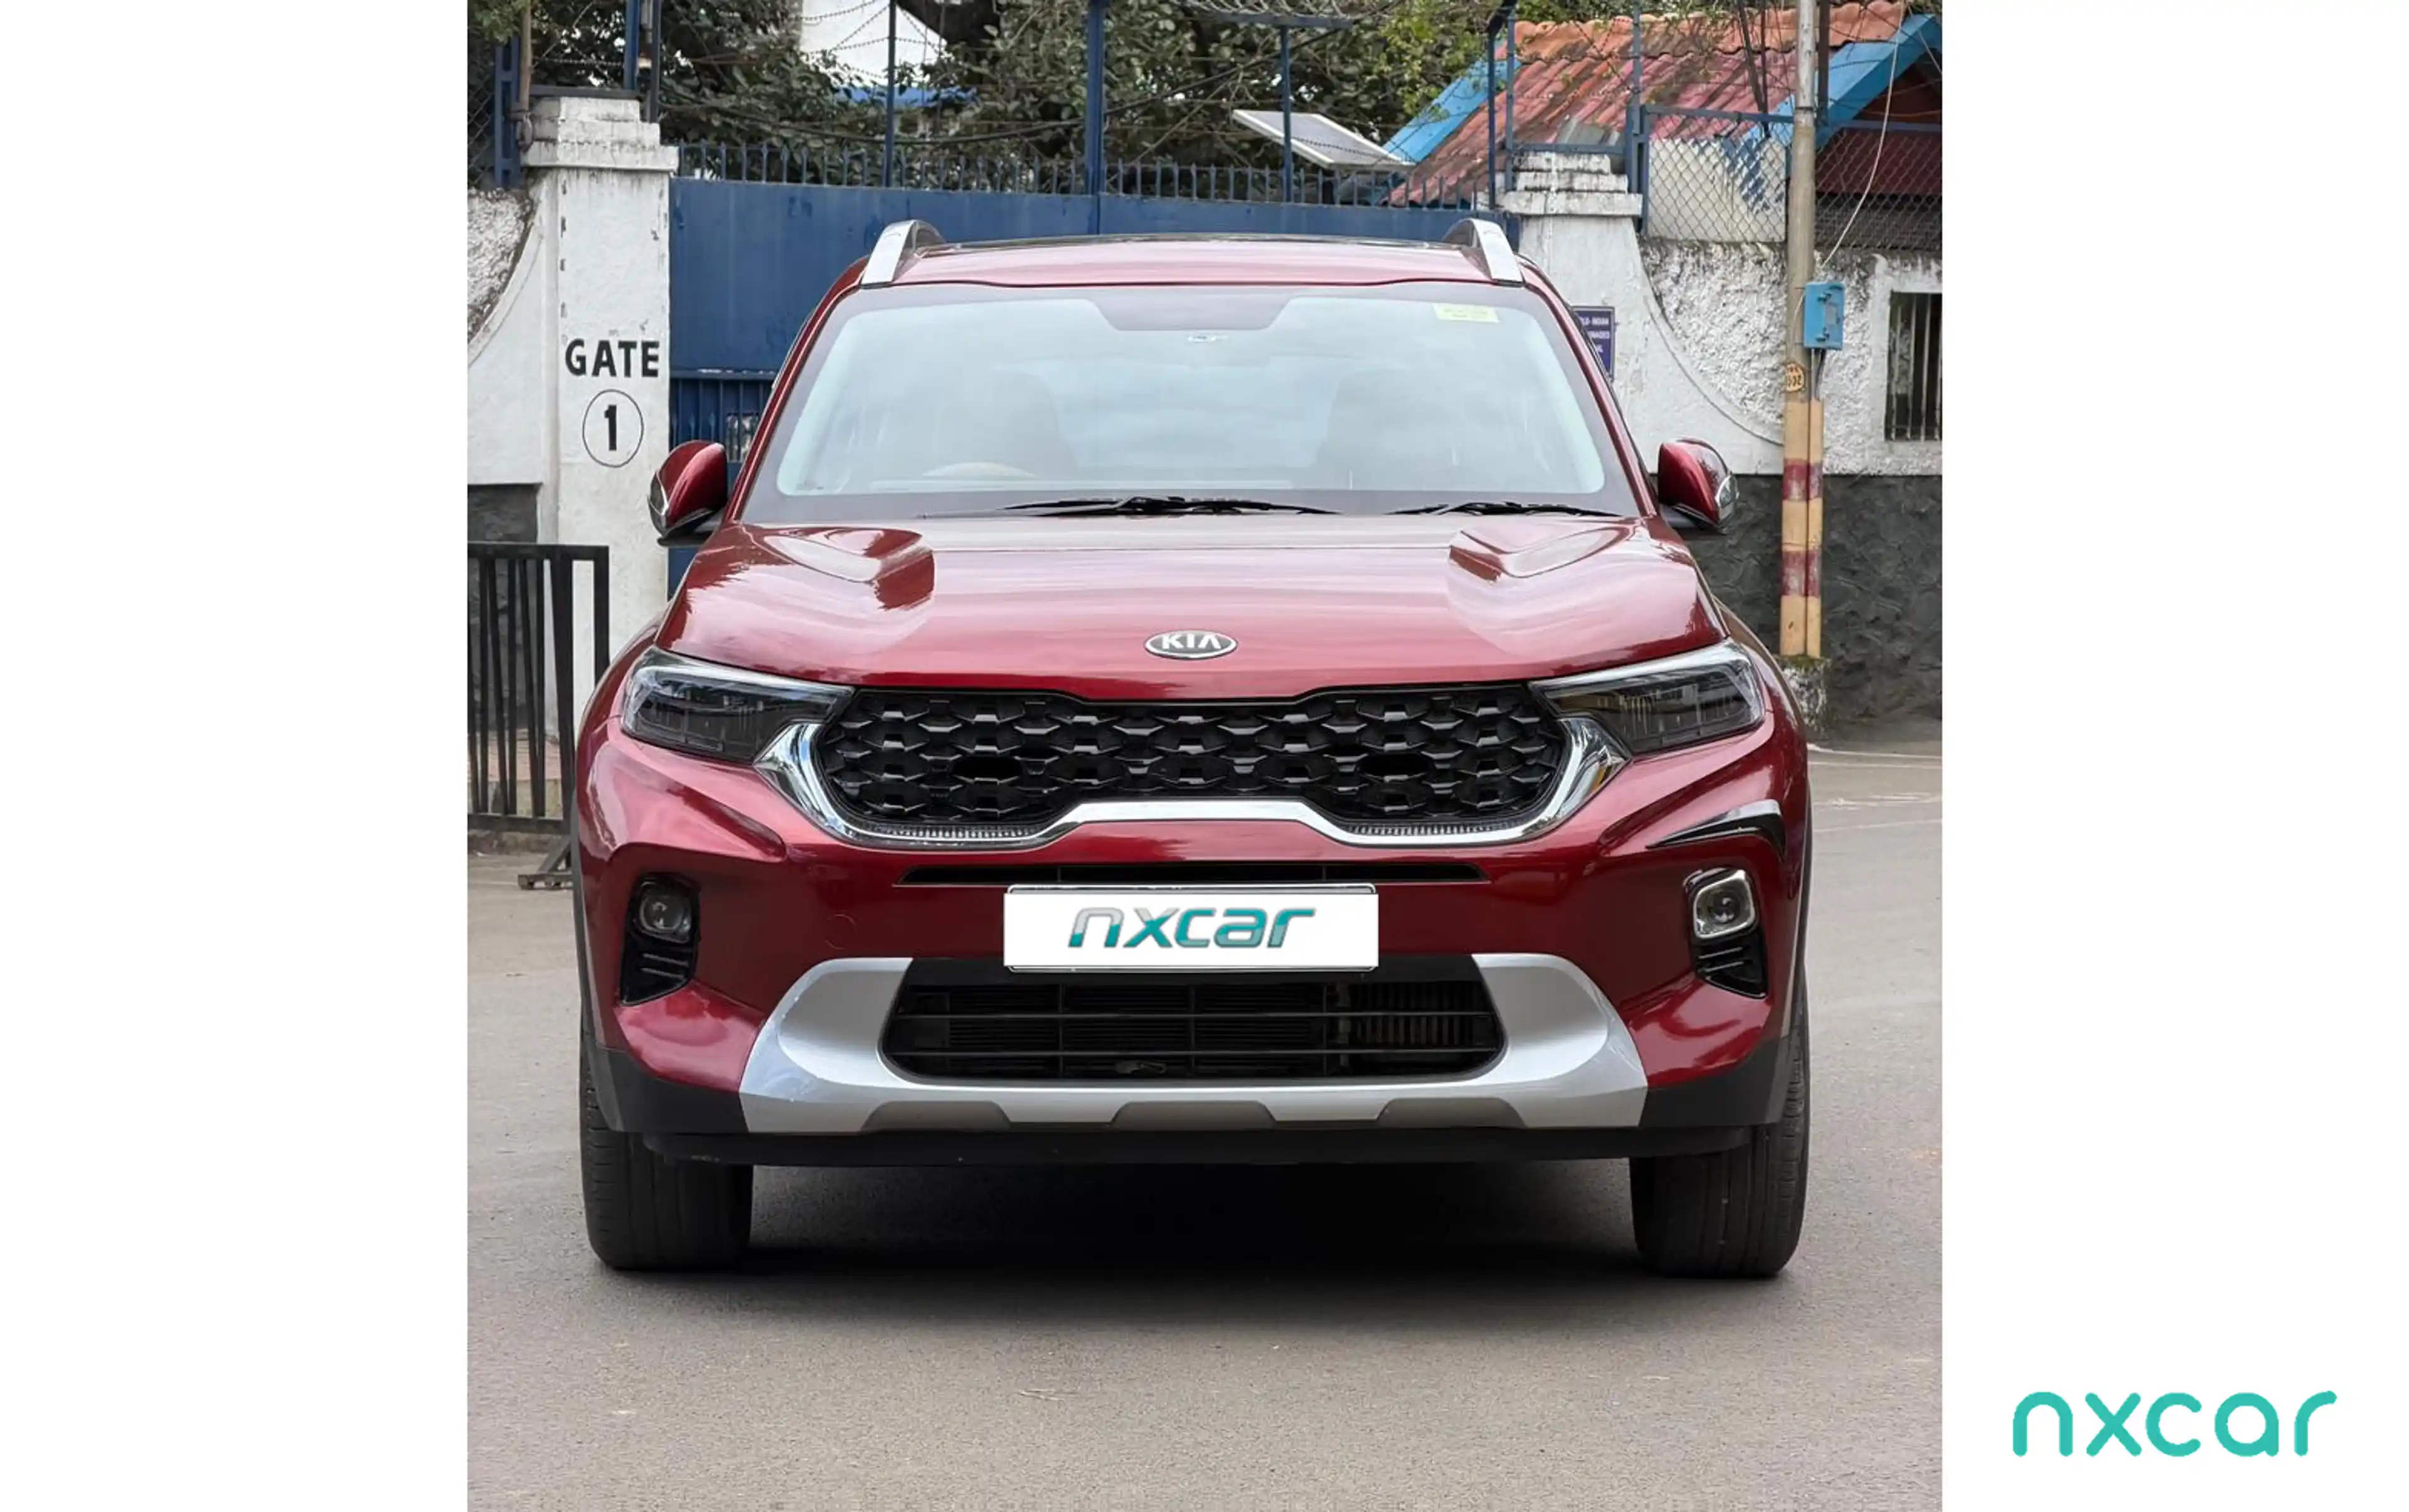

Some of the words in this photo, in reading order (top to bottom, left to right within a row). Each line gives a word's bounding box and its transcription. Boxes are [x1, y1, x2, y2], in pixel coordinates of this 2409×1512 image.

[565, 339, 659, 377] GATE
[604, 405, 617, 450] 1
[1162, 634, 1221, 649] KIA
